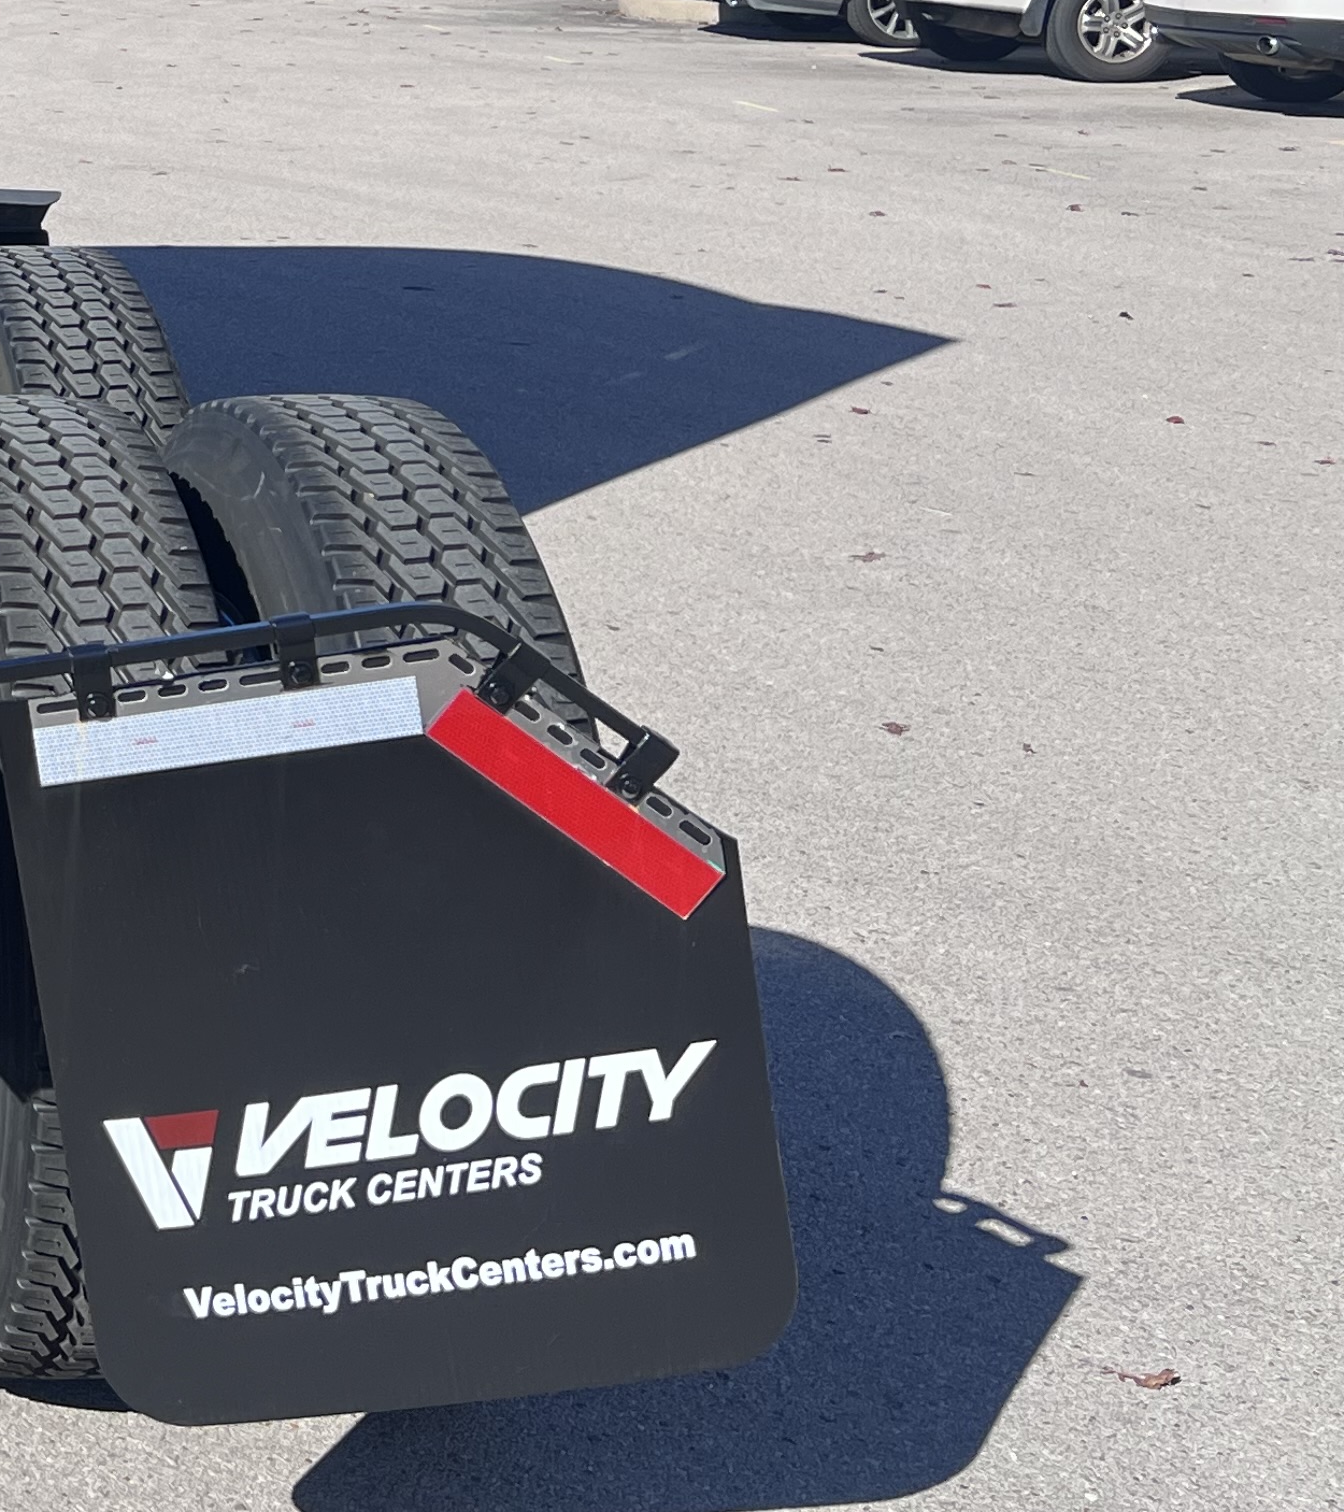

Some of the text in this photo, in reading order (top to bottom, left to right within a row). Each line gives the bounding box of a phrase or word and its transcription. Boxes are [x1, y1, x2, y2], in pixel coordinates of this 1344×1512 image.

[235, 1039, 717, 1177] VELOCITY
[227, 1152, 543, 1222] TRUCK CENTERS
[183, 1233, 697, 1319] VelocityTruckCenters.com
